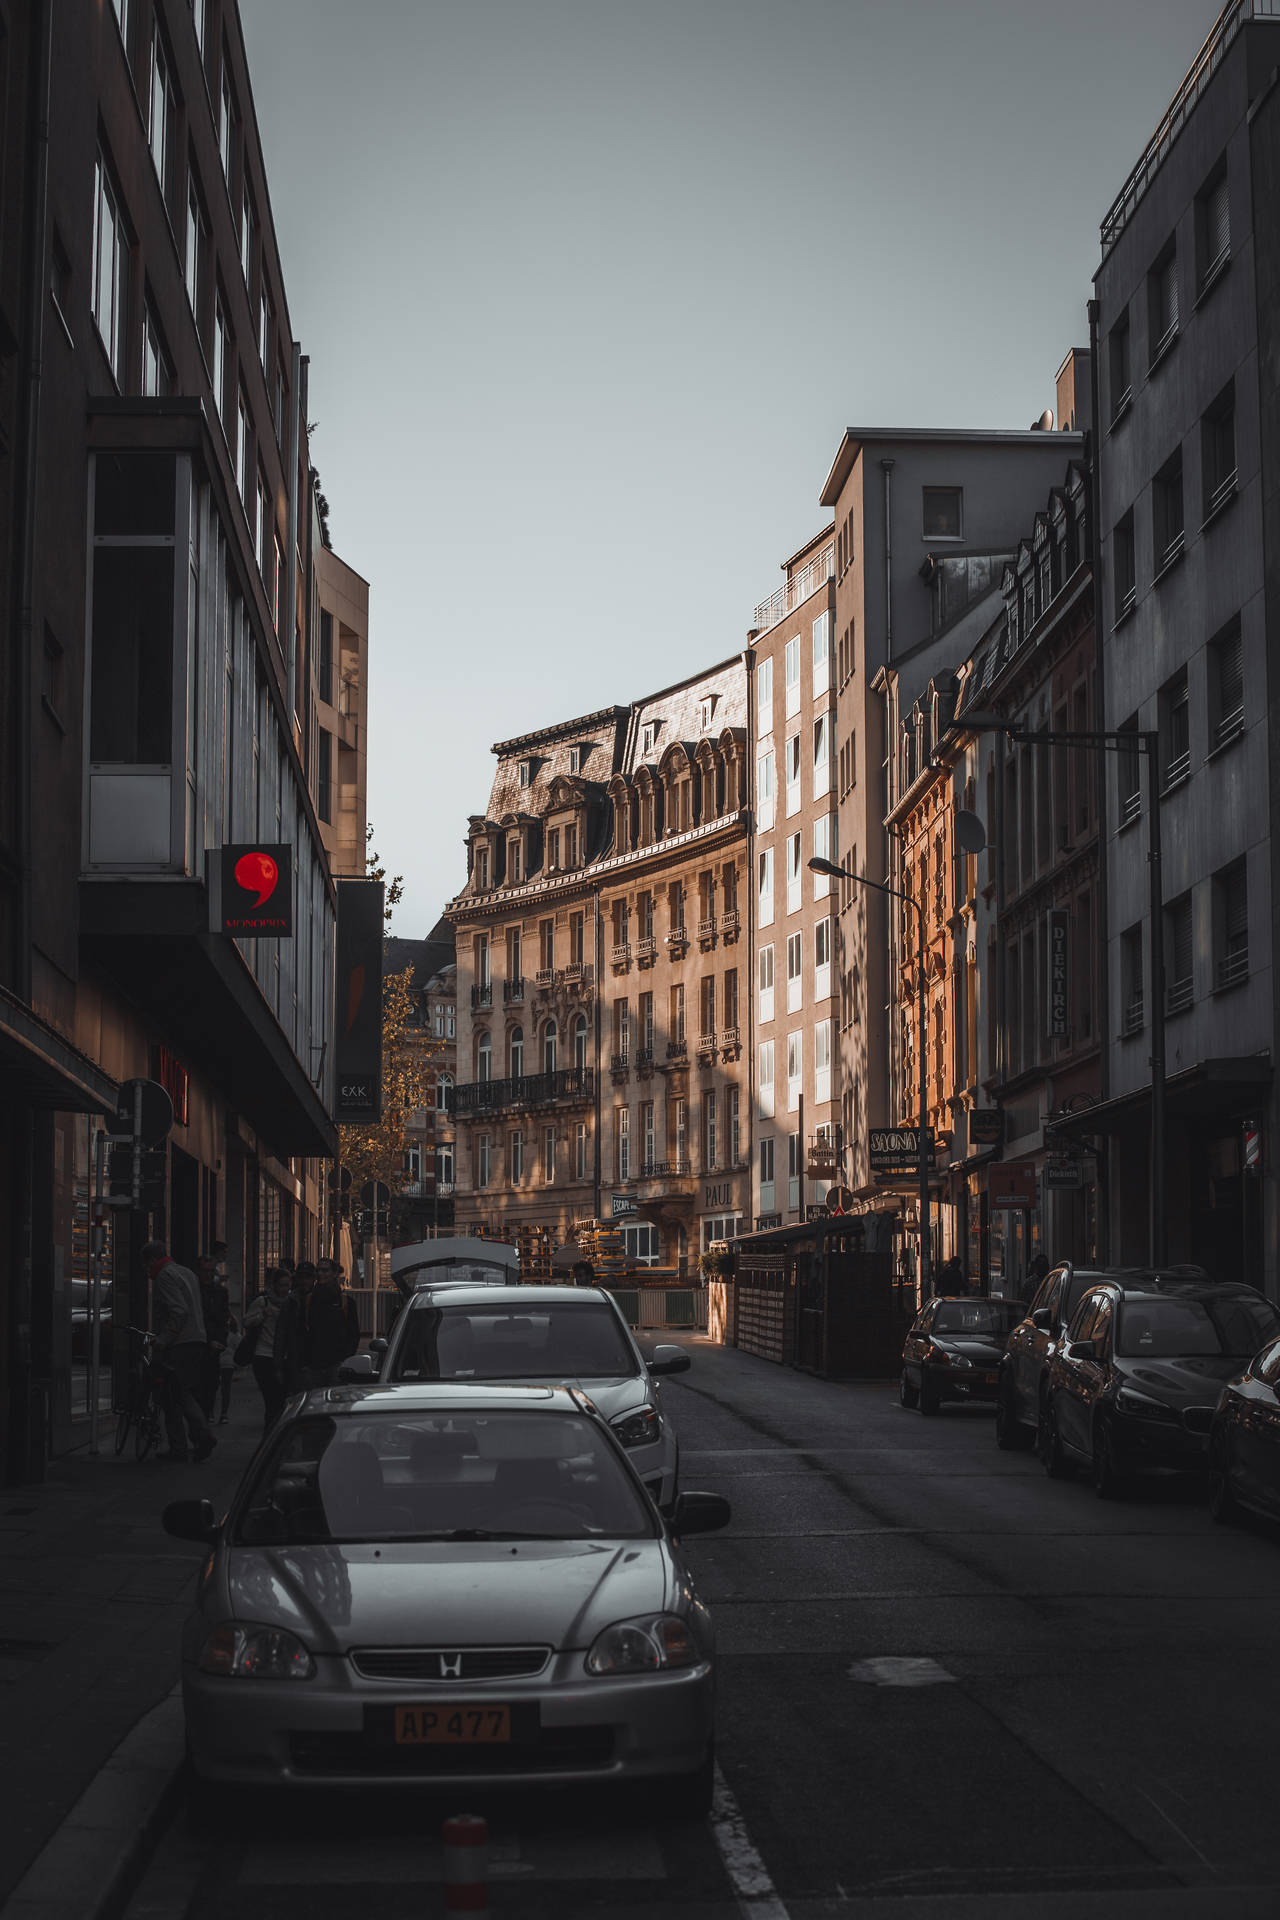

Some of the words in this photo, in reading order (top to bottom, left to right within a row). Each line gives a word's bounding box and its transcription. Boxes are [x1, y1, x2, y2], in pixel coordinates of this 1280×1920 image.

[1054, 927, 1065, 1033] DIEKIRCH
[871, 1132, 917, 1152] SAONA
[705, 1184, 732, 1207] PAUL
[402, 1711, 438, 1737] AP
[447, 1711, 505, 1737] 477
